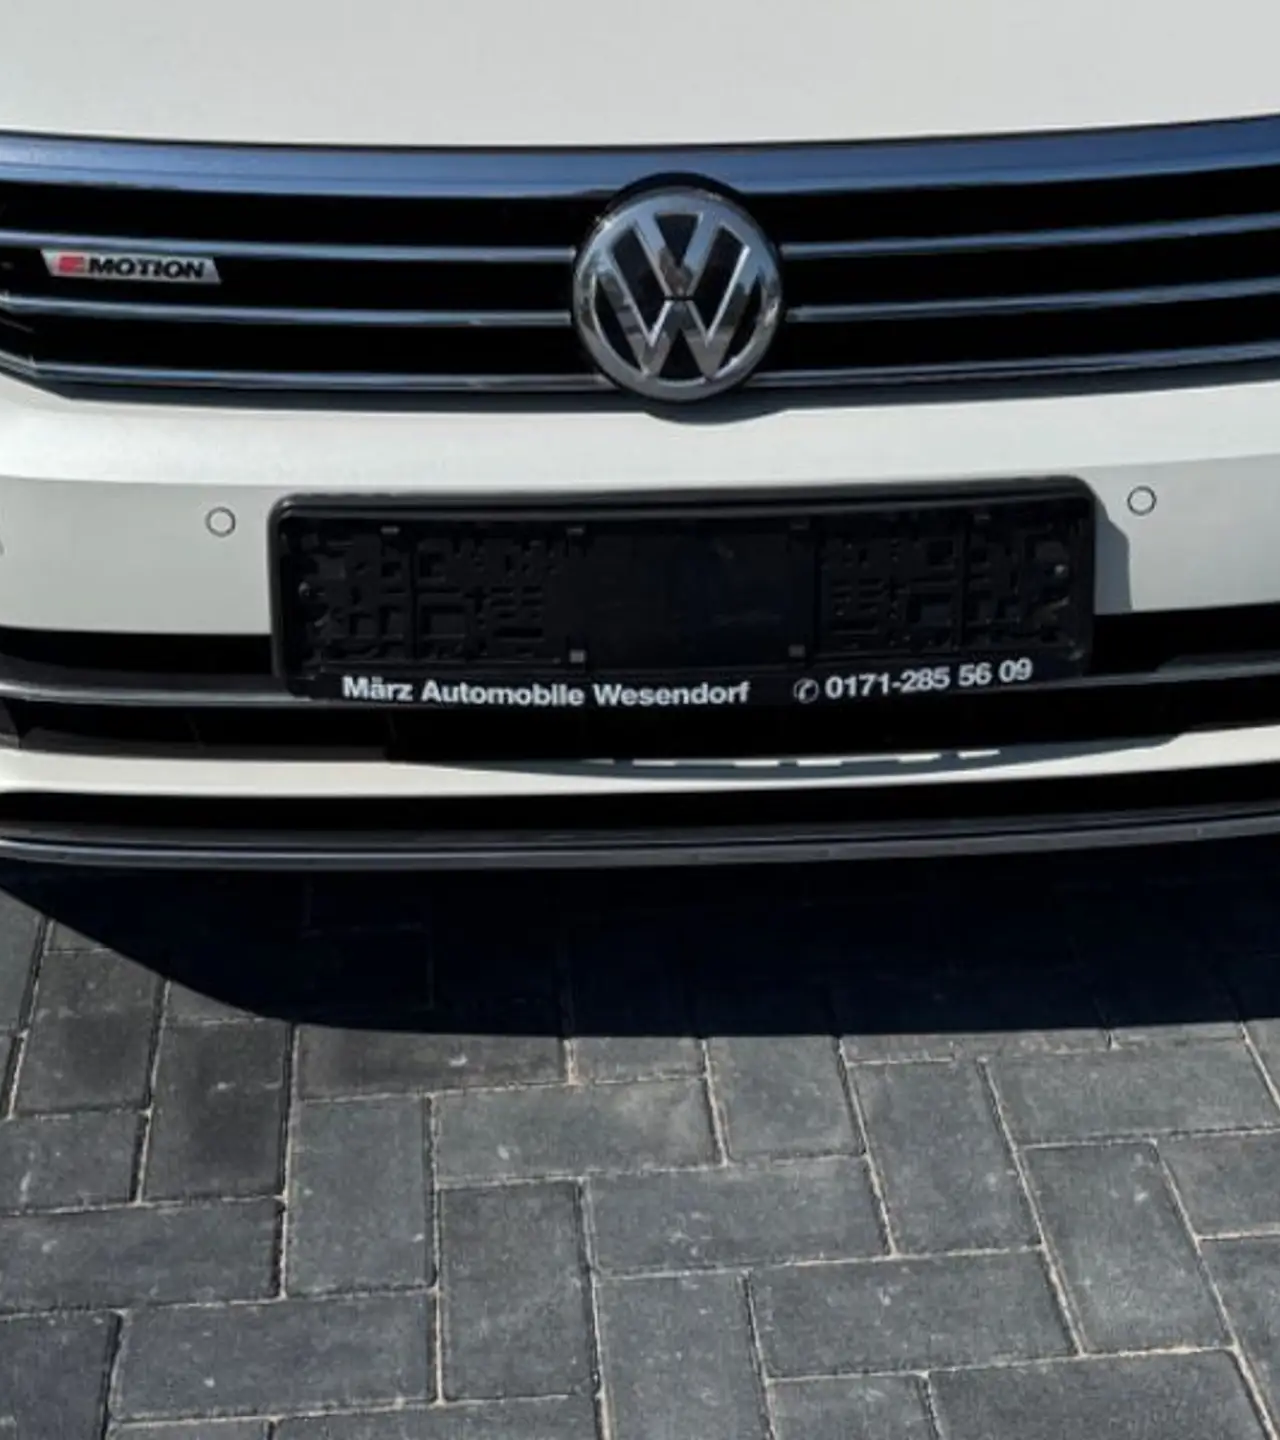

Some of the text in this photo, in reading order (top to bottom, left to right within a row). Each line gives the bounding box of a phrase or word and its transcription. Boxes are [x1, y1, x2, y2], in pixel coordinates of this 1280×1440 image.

[582, 194, 772, 394] VW
[342, 674, 750, 707] März Automobile Wesendorf
[825, 657, 1033, 700] 0171-285 56 09
